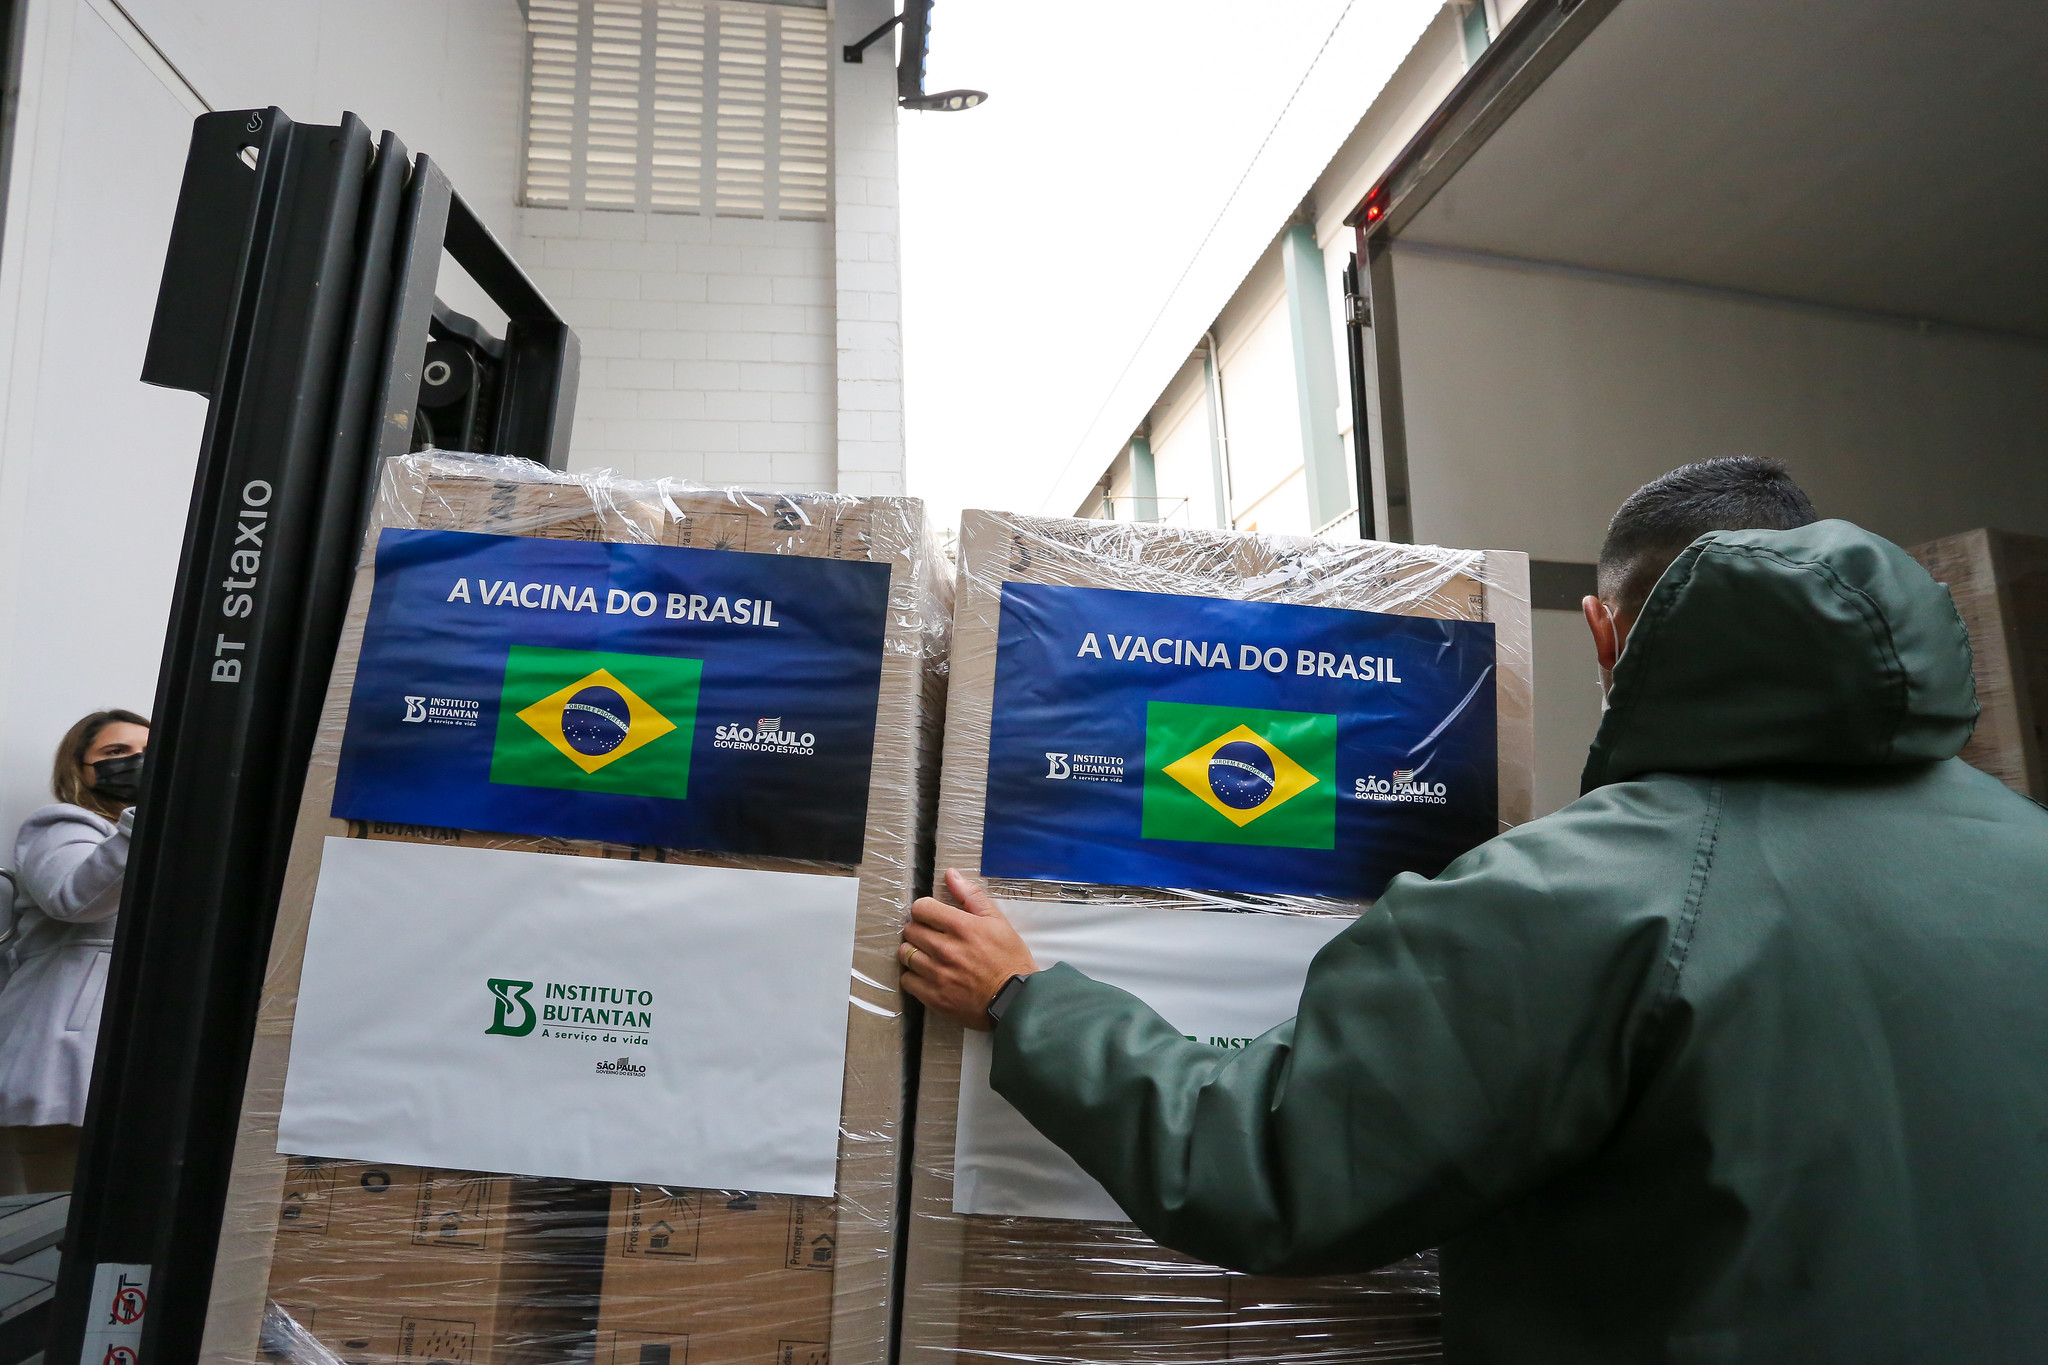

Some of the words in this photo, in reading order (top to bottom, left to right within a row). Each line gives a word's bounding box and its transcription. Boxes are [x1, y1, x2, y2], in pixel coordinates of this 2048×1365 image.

[446, 577, 471, 604] A
[478, 579, 598, 613] VACINA
[605, 588, 658, 617] DO
[665, 593, 780, 627] BRASIL
[210, 633, 246, 683] BT
[1077, 632, 1102, 659] A
[1107, 634, 1231, 670] VACINA
[1239, 644, 1289, 673] DO
[1296, 649, 1402, 684] BRASIL
[428, 707, 479, 719] BUTANTAN
[430, 697, 480, 709] INSTITUTO
[714, 722, 754, 742] SÃO
[755, 730, 816, 747] PAULO
[713, 740, 760, 751] GOVERNO
[760, 744, 776, 752] DO
[776, 745, 814, 756] ESTADO
[1072, 764, 1124, 775] BUTANTAN
[1073, 754, 1124, 766] INSTITUTO
[1355, 775, 1391, 793] SÃO
[1392, 781, 1447, 797] PAULO
[1354, 791, 1398, 802] GOVERNO
[1398, 794, 1413, 802] DO
[1413, 795, 1447, 805] ESTADO
[373, 821, 462, 842] BUTANTAN
[545, 983, 653, 1006] INSTITUTO
[543, 1004, 652, 1028] BUTANTAN
[541, 1029, 550, 1037] A
[554, 1031, 597, 1043] serviço
[602, 1033, 617, 1044] da
[622, 1034, 649, 1046] vida
[1210, 1036, 1253, 1049] INST
[596, 1060, 616, 1071] SÃO
[616, 1064, 647, 1073] PAULO
[626, 1212, 641, 1254] Proteger
[790, 1226, 805, 1265] Proteger
